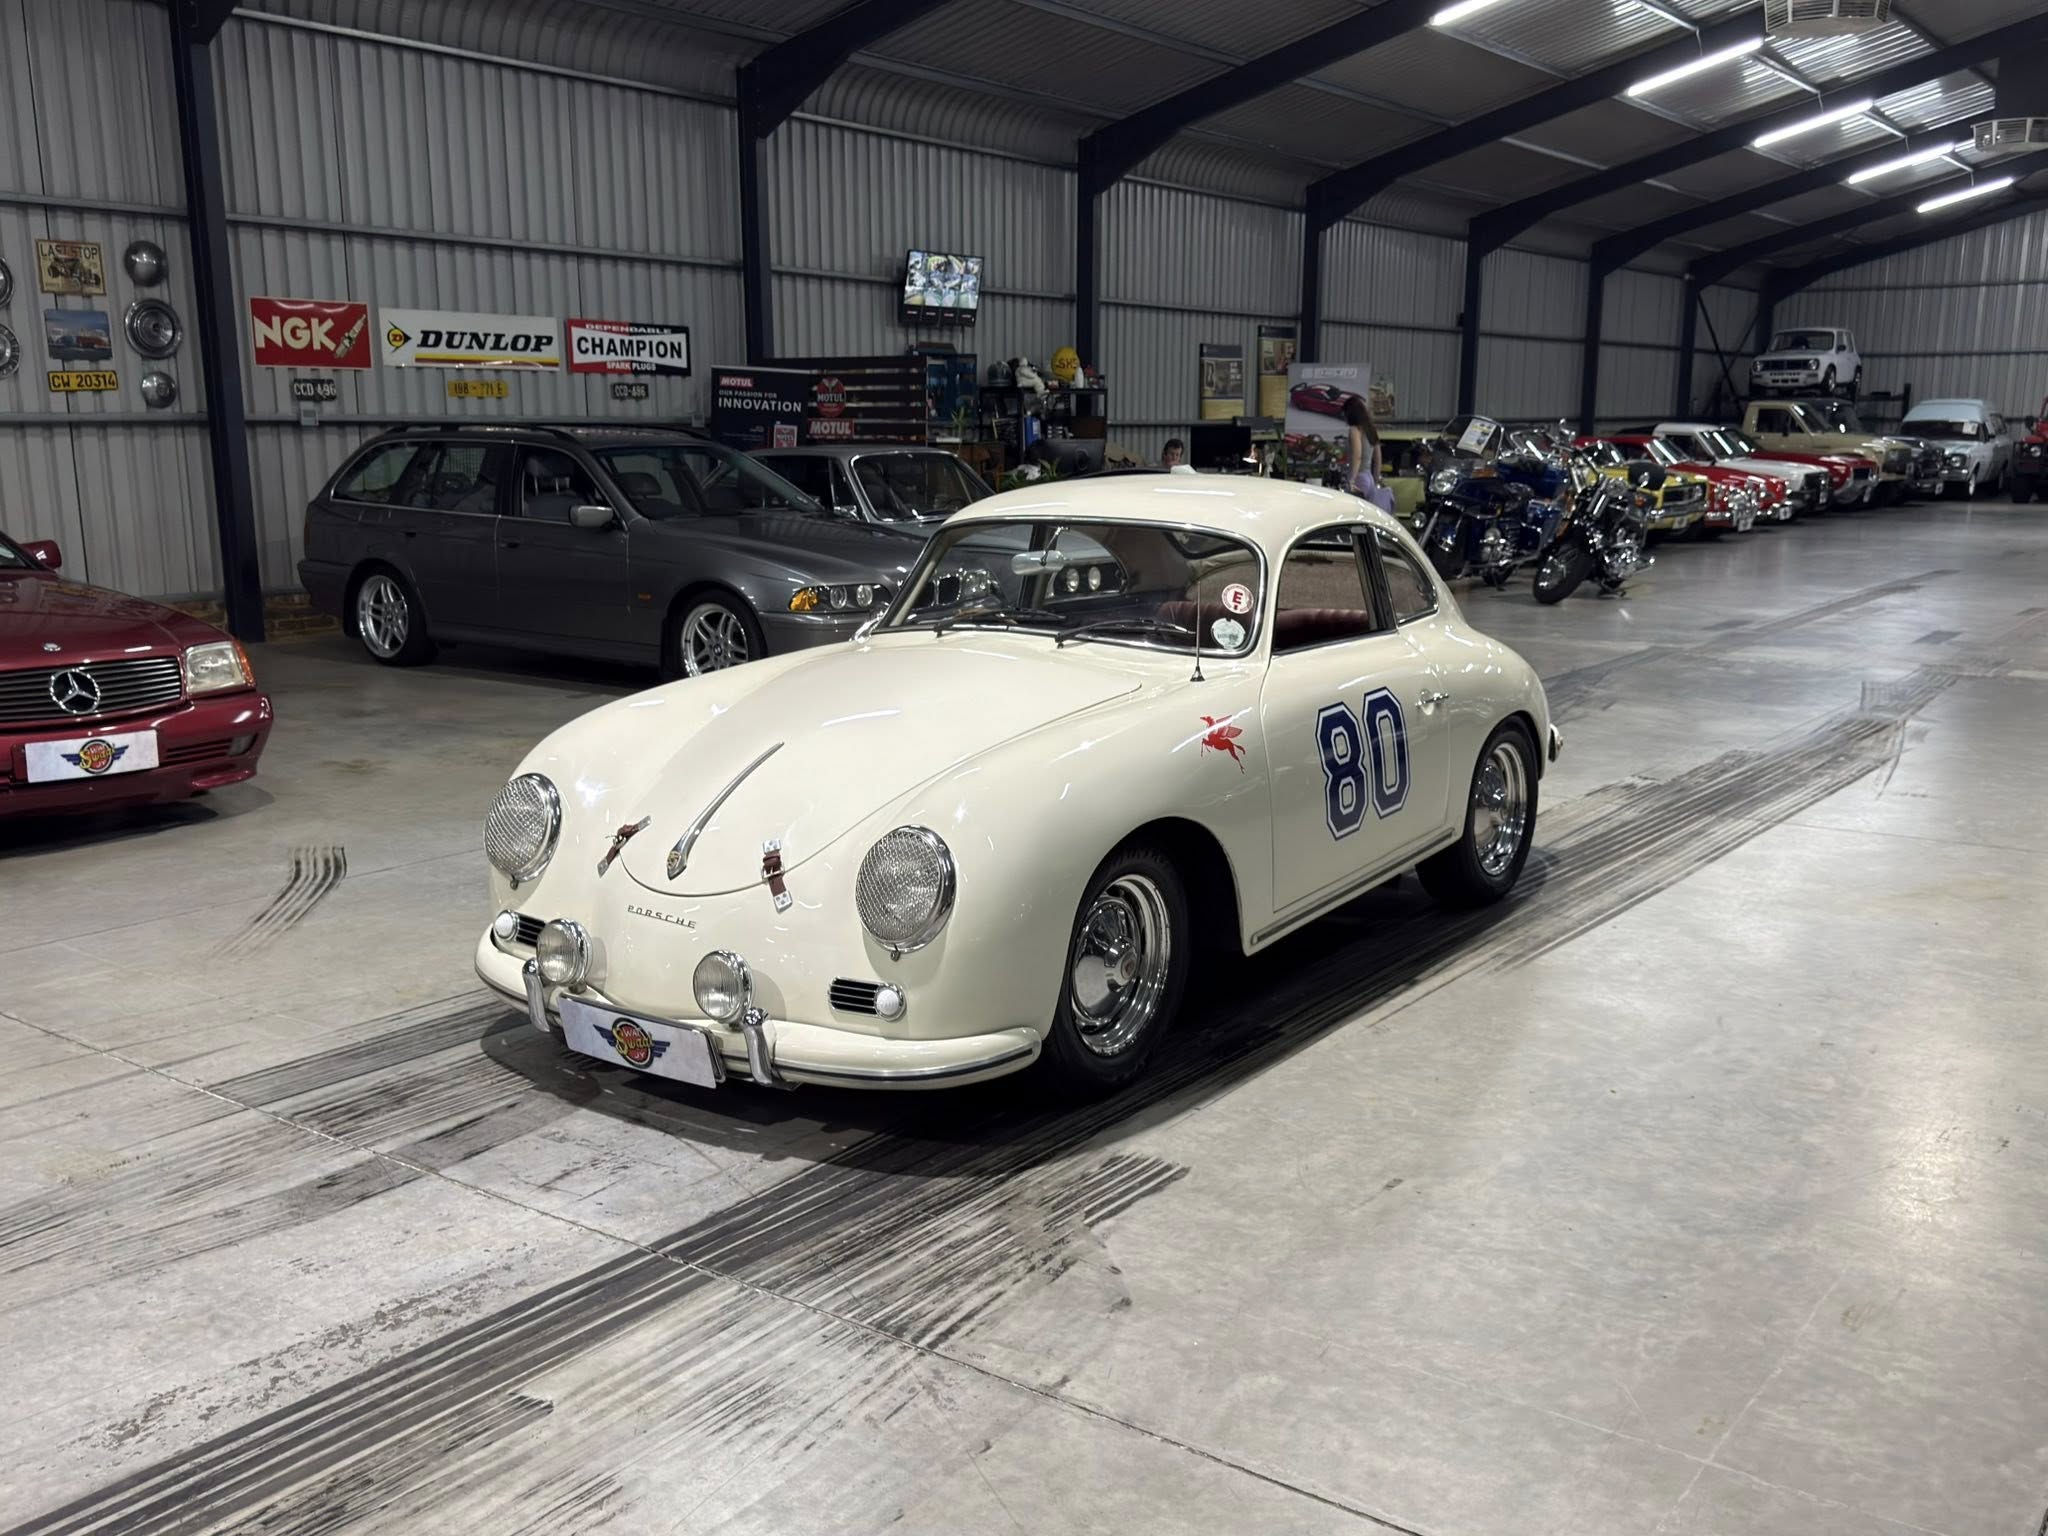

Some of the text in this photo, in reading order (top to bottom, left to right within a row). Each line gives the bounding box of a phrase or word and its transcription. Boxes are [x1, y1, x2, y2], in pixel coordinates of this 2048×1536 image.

[40, 243, 98, 260] LAST STOP
[253, 315, 337, 352] NGK
[584, 323, 672, 335] DEPENDABLE
[416, 329, 553, 352] DUNLOP
[576, 336, 682, 359] CHAMPION
[606, 361, 657, 371] SPARK PLUGS
[51, 373, 116, 388] CW 20314
[720, 377, 753, 387] MOTUL
[293, 382, 314, 396] CCD
[734, 390, 763, 398] PASSION
[718, 397, 802, 413] INNOVATION
[817, 392, 844, 403] MOTUL
[809, 421, 852, 435] MOTUL
[1232, 590, 1243, 605] E
[1315, 686, 1411, 841] 80
[627, 904, 696, 929] PORSCHE
